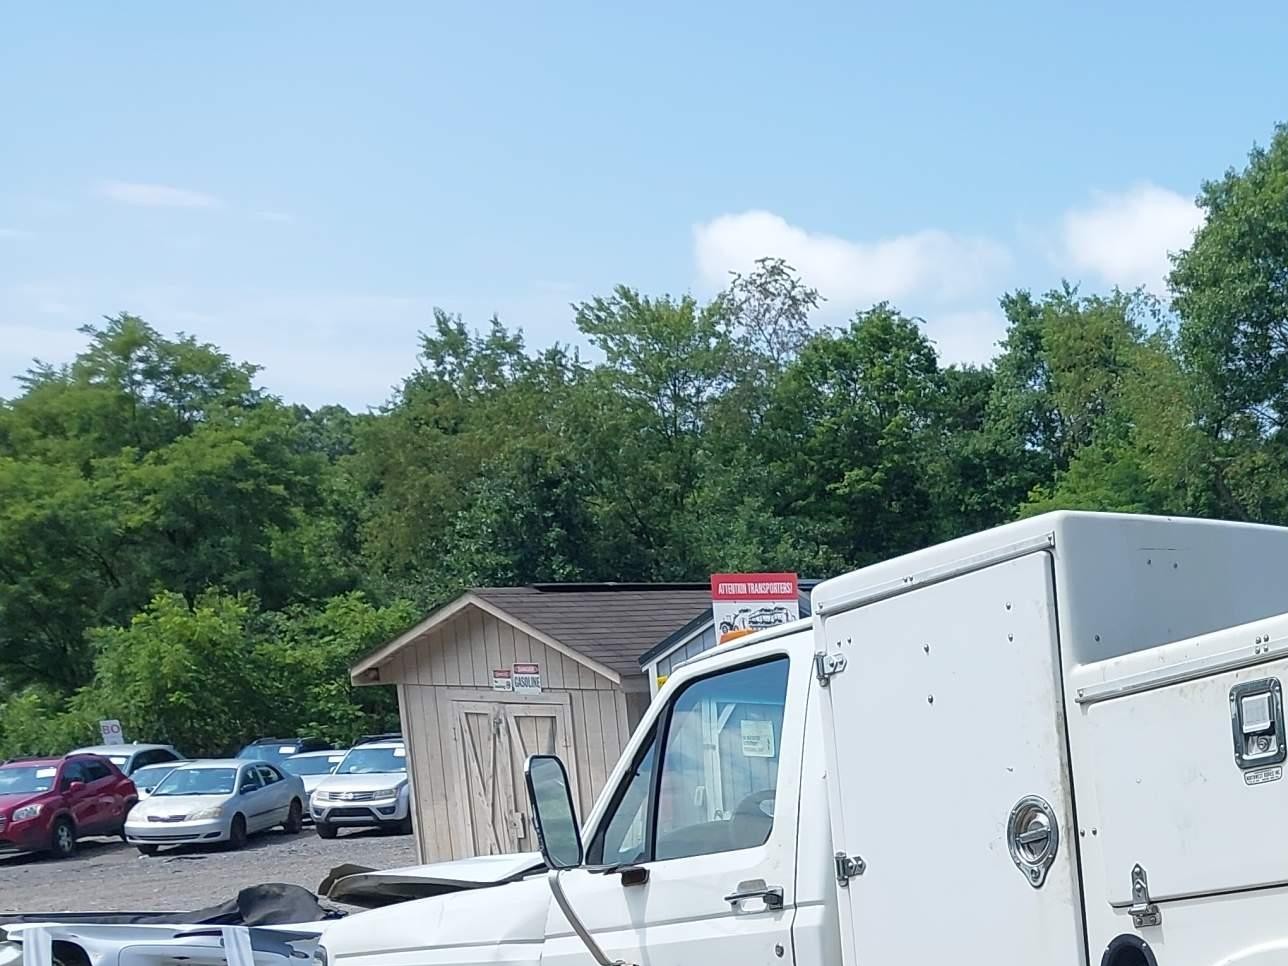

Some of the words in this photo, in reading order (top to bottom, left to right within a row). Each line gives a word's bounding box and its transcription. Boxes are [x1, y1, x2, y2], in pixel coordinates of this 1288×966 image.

[718, 583, 747, 594] ATTENTION
[747, 582, 793, 594] TRANSPORTERS!
[514, 676, 540, 689] GASOLINE
